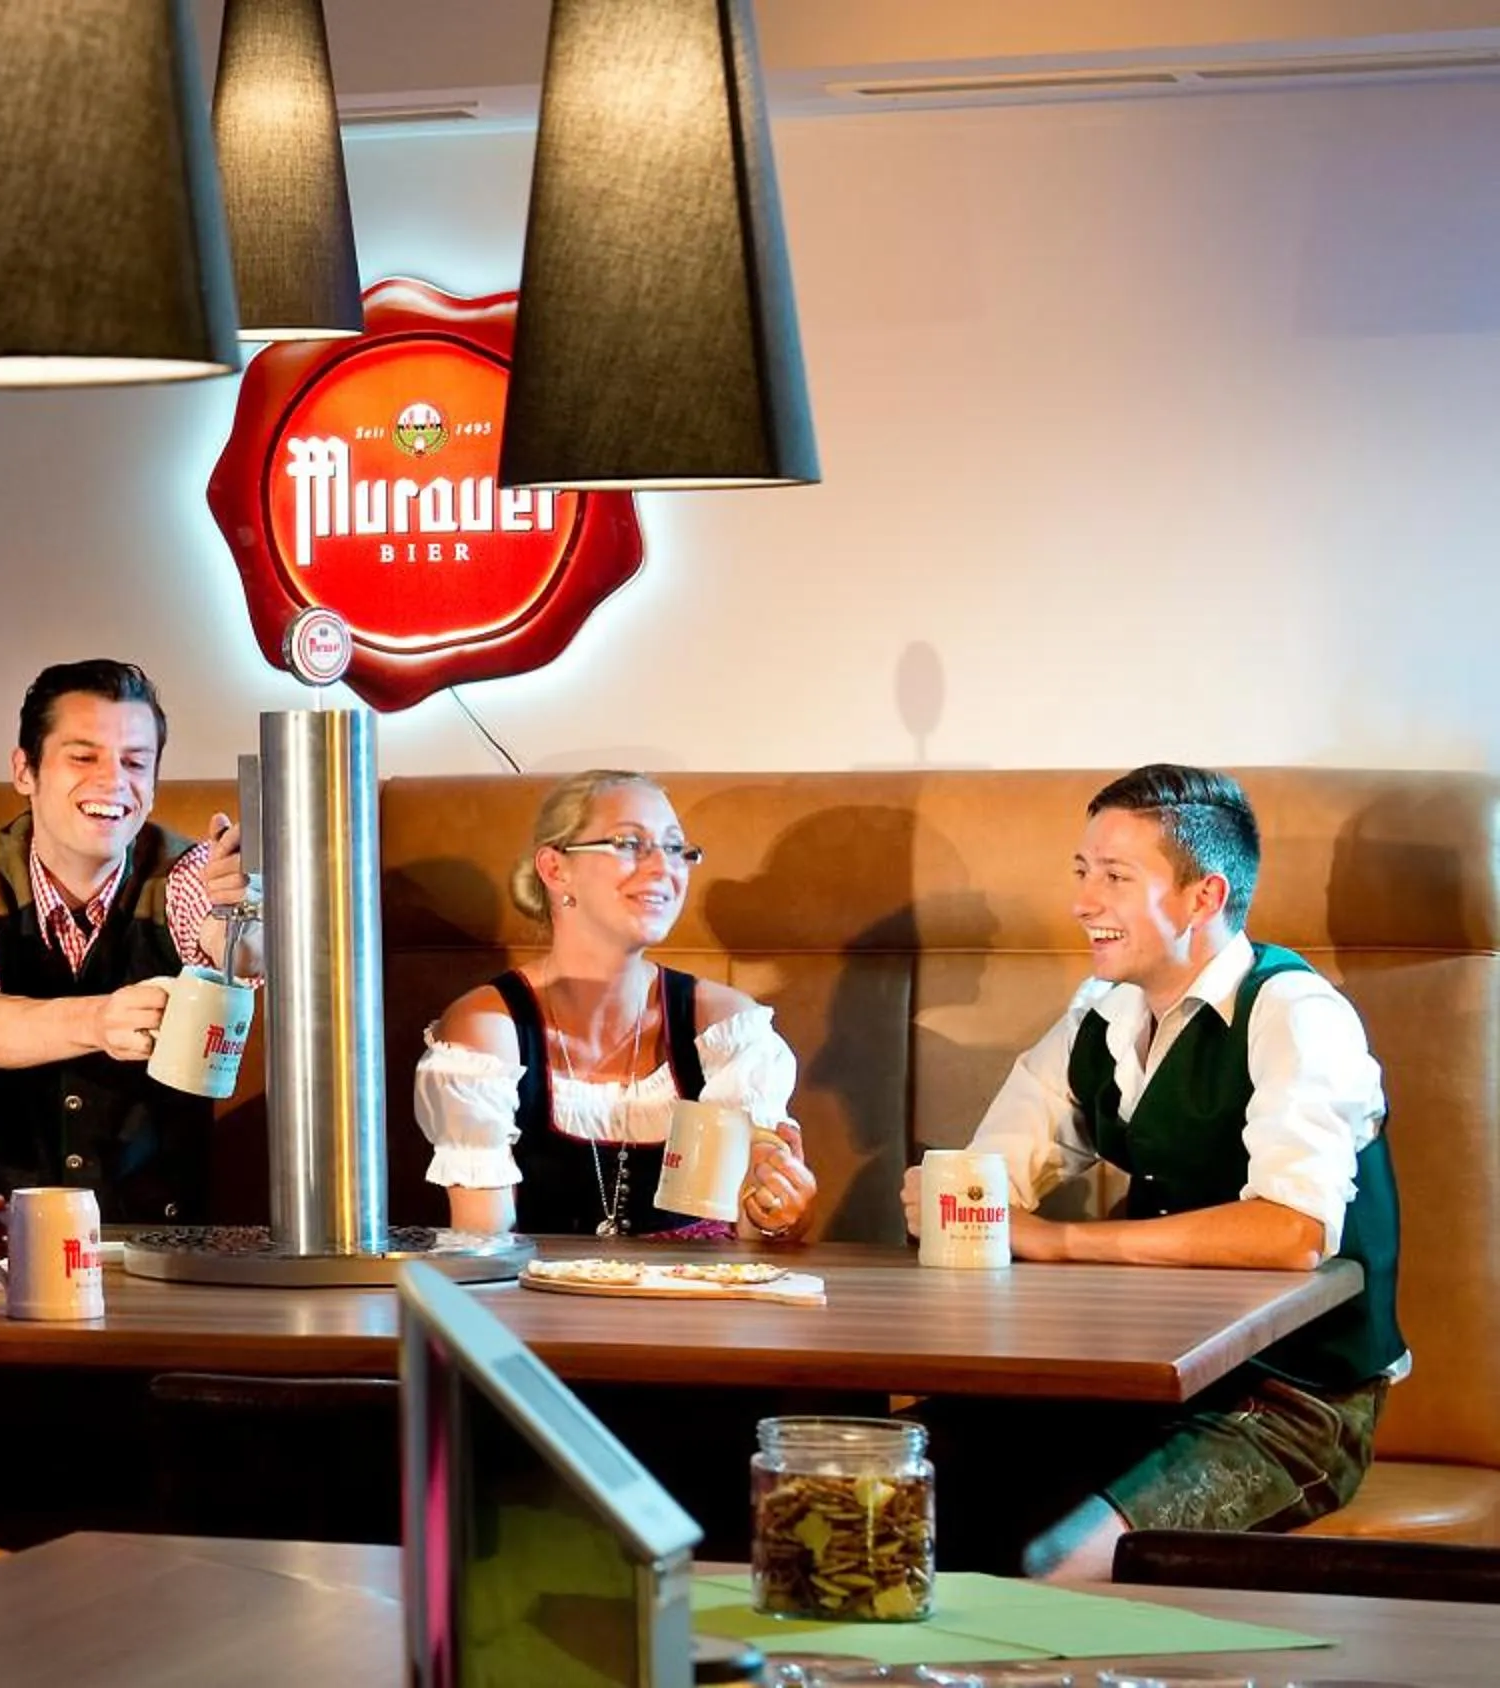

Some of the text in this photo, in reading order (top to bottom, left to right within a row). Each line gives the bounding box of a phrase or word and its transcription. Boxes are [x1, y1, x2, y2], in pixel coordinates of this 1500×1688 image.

[355, 421, 492, 440] Seit 1495
[286, 436, 562, 566] Murauer
[380, 543, 470, 563] BIER
